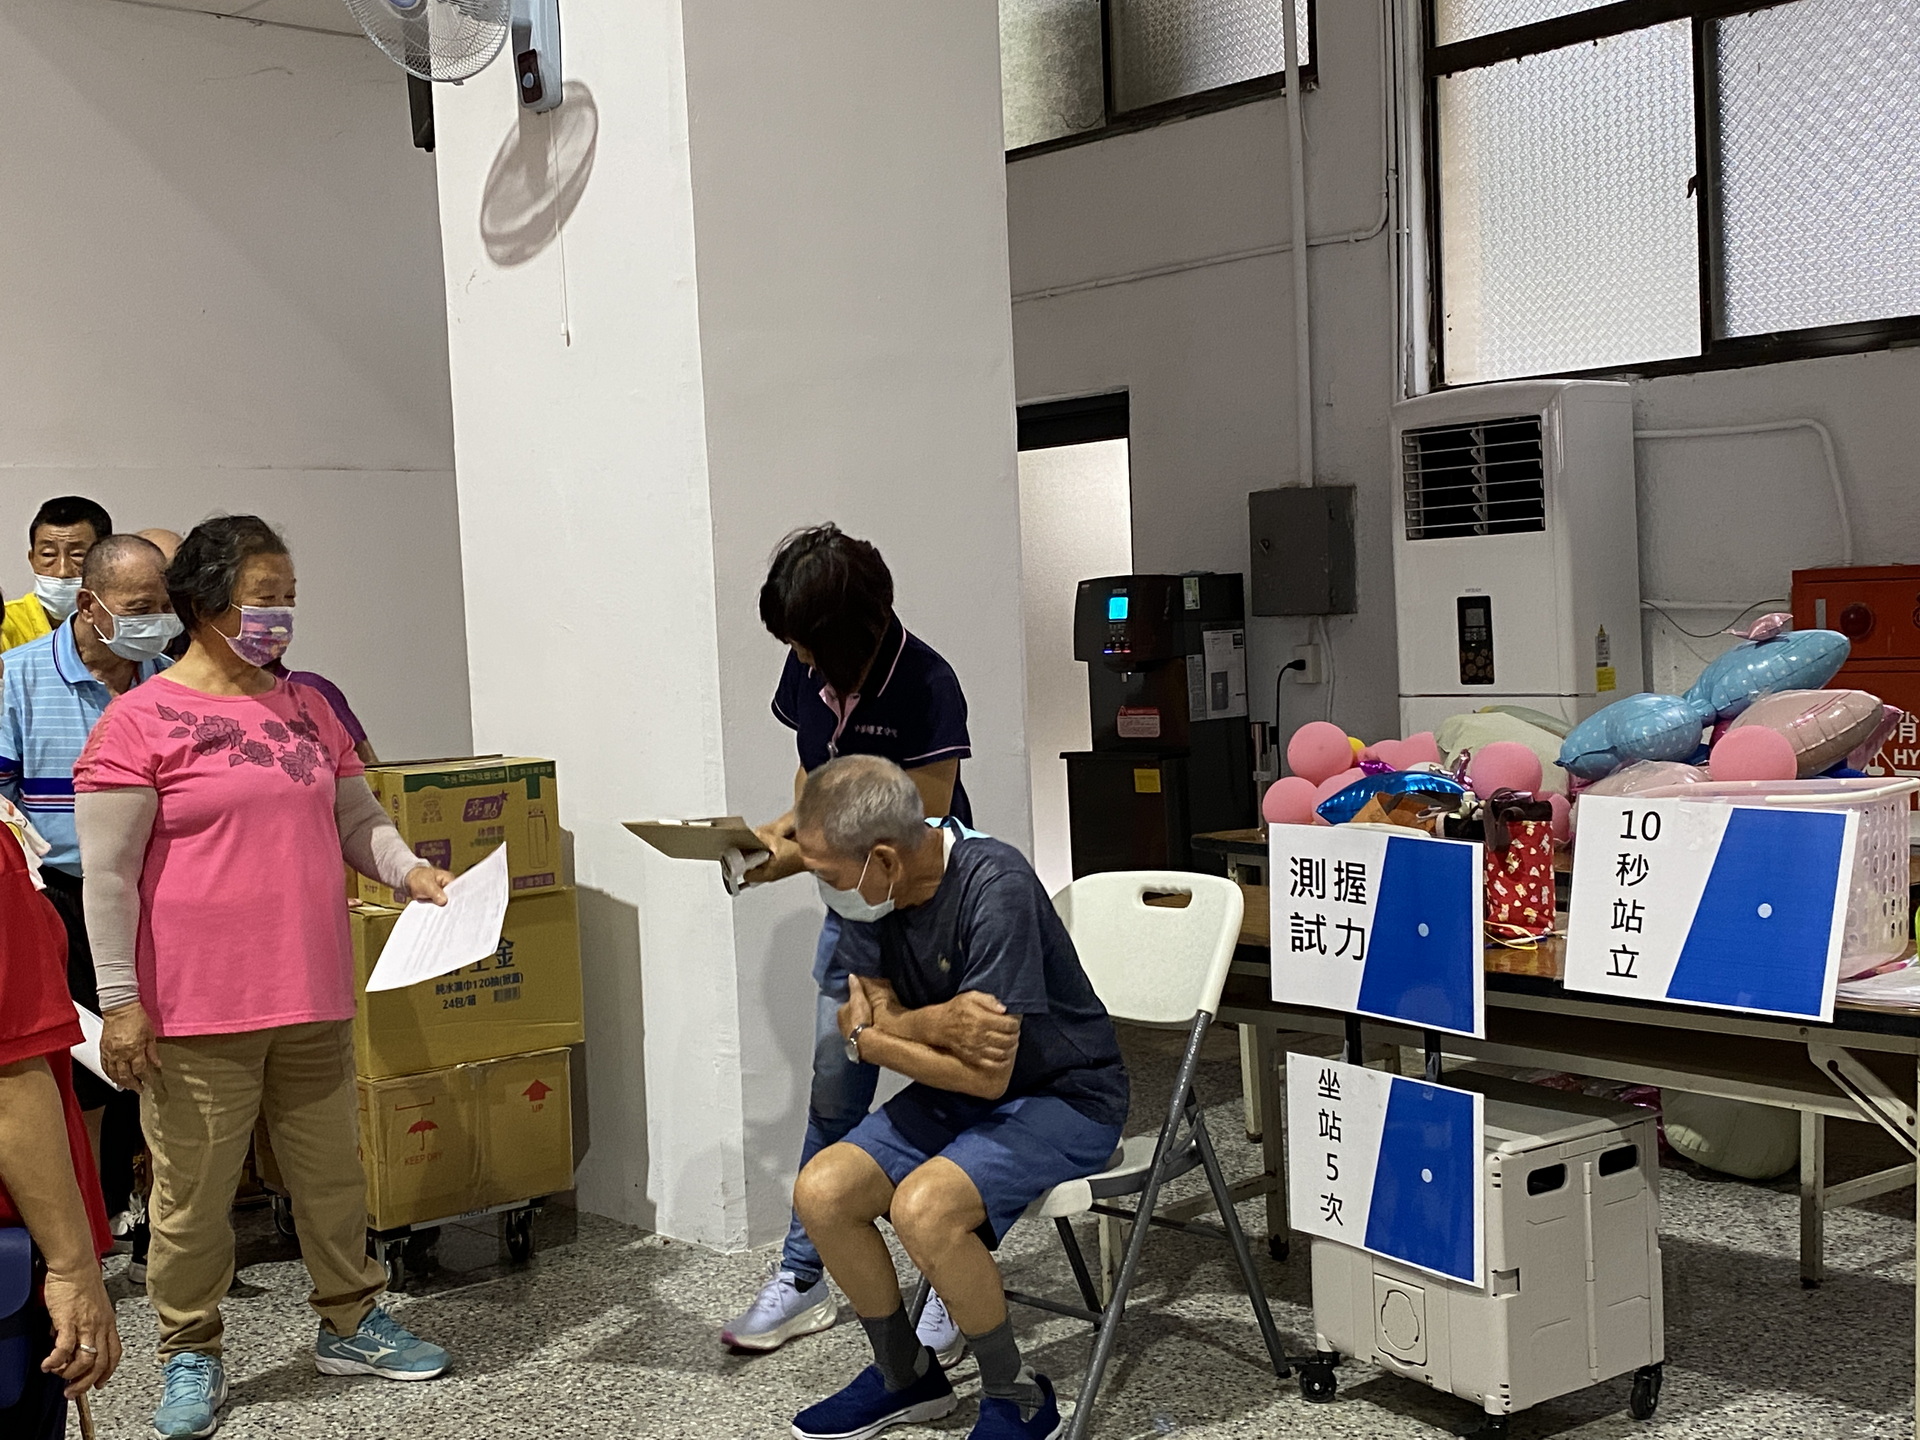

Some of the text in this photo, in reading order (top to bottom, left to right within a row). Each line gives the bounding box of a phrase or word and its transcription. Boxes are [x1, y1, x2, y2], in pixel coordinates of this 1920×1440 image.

[1289, 856, 1327, 955] 測試
[1333, 860, 1367, 961] 握力
[1606, 809, 1662, 979] 10秒站立
[532, 1103, 544, 1113] UP
[1317, 1068, 1344, 1226] 坐站5次
[404, 1151, 443, 1166] KEEP DRY
